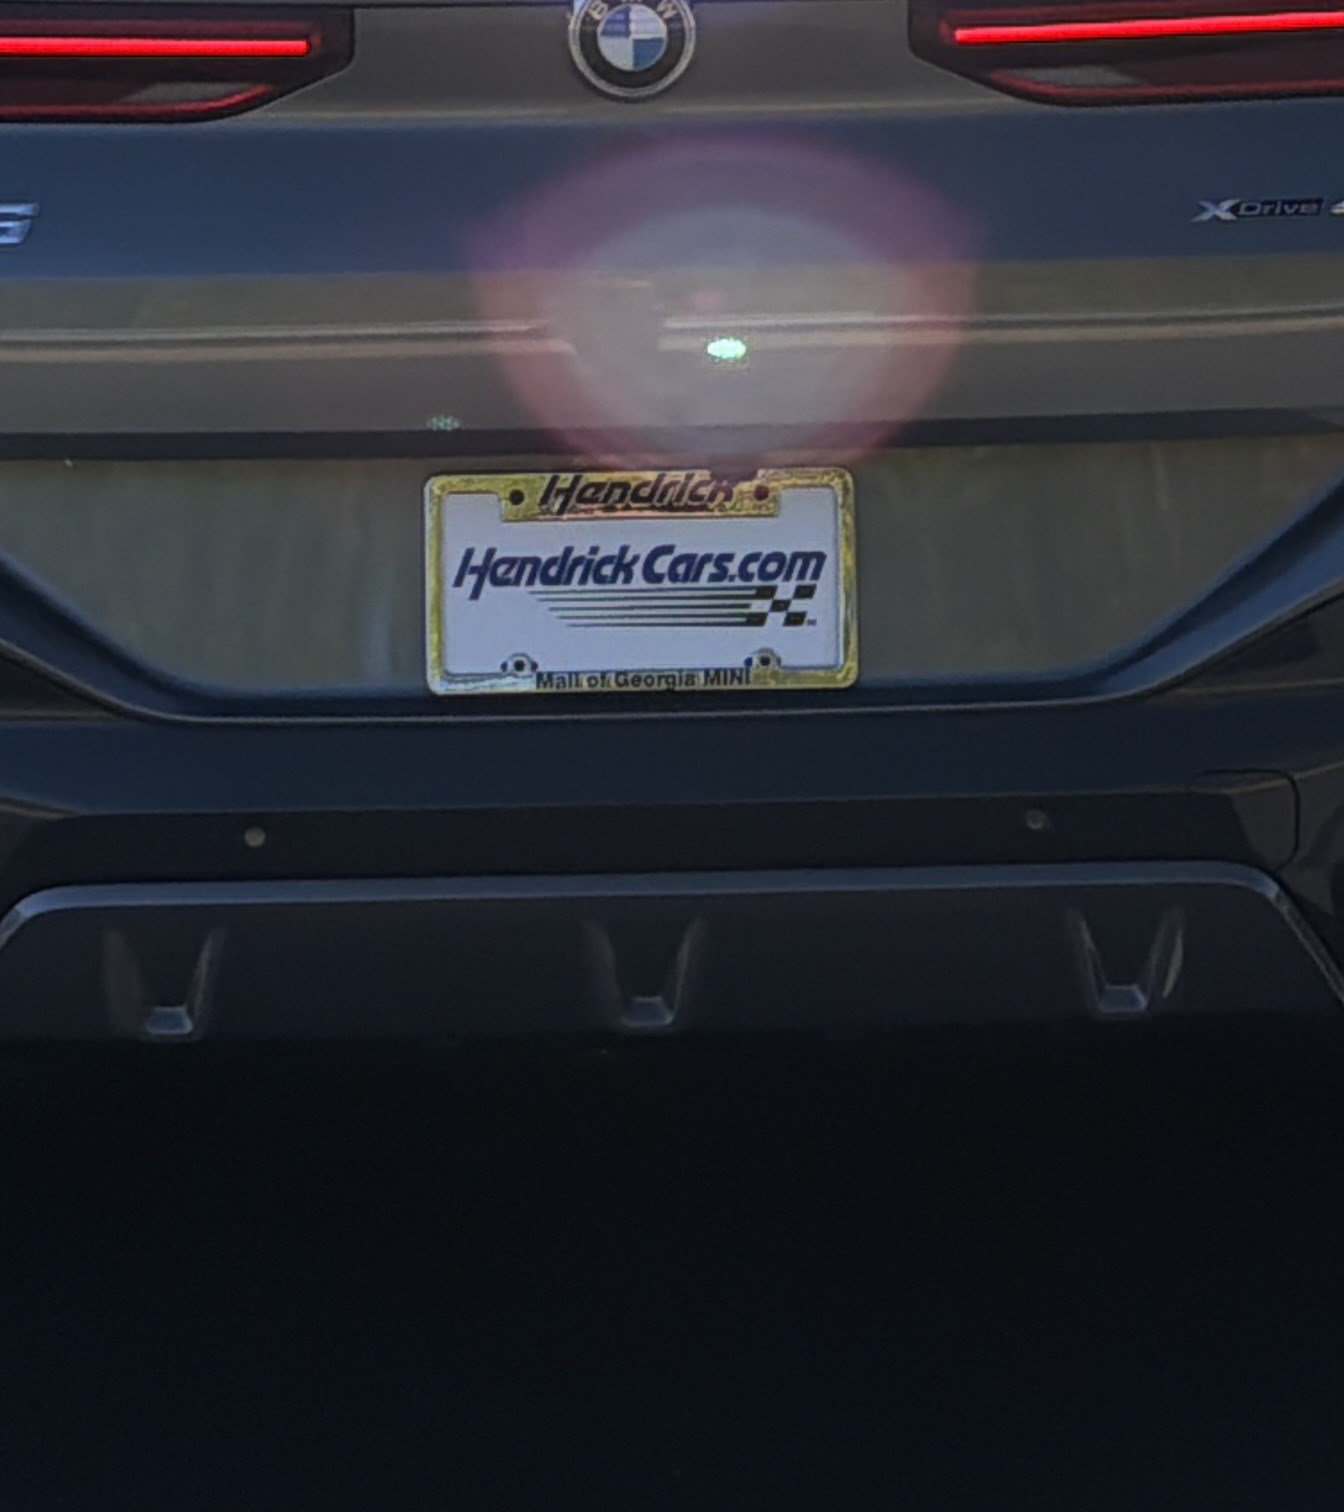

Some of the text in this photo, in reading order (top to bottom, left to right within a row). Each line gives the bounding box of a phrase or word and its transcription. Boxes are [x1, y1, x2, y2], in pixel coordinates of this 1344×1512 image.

[535, 667, 752, 691] Mall of Georgia MINI
